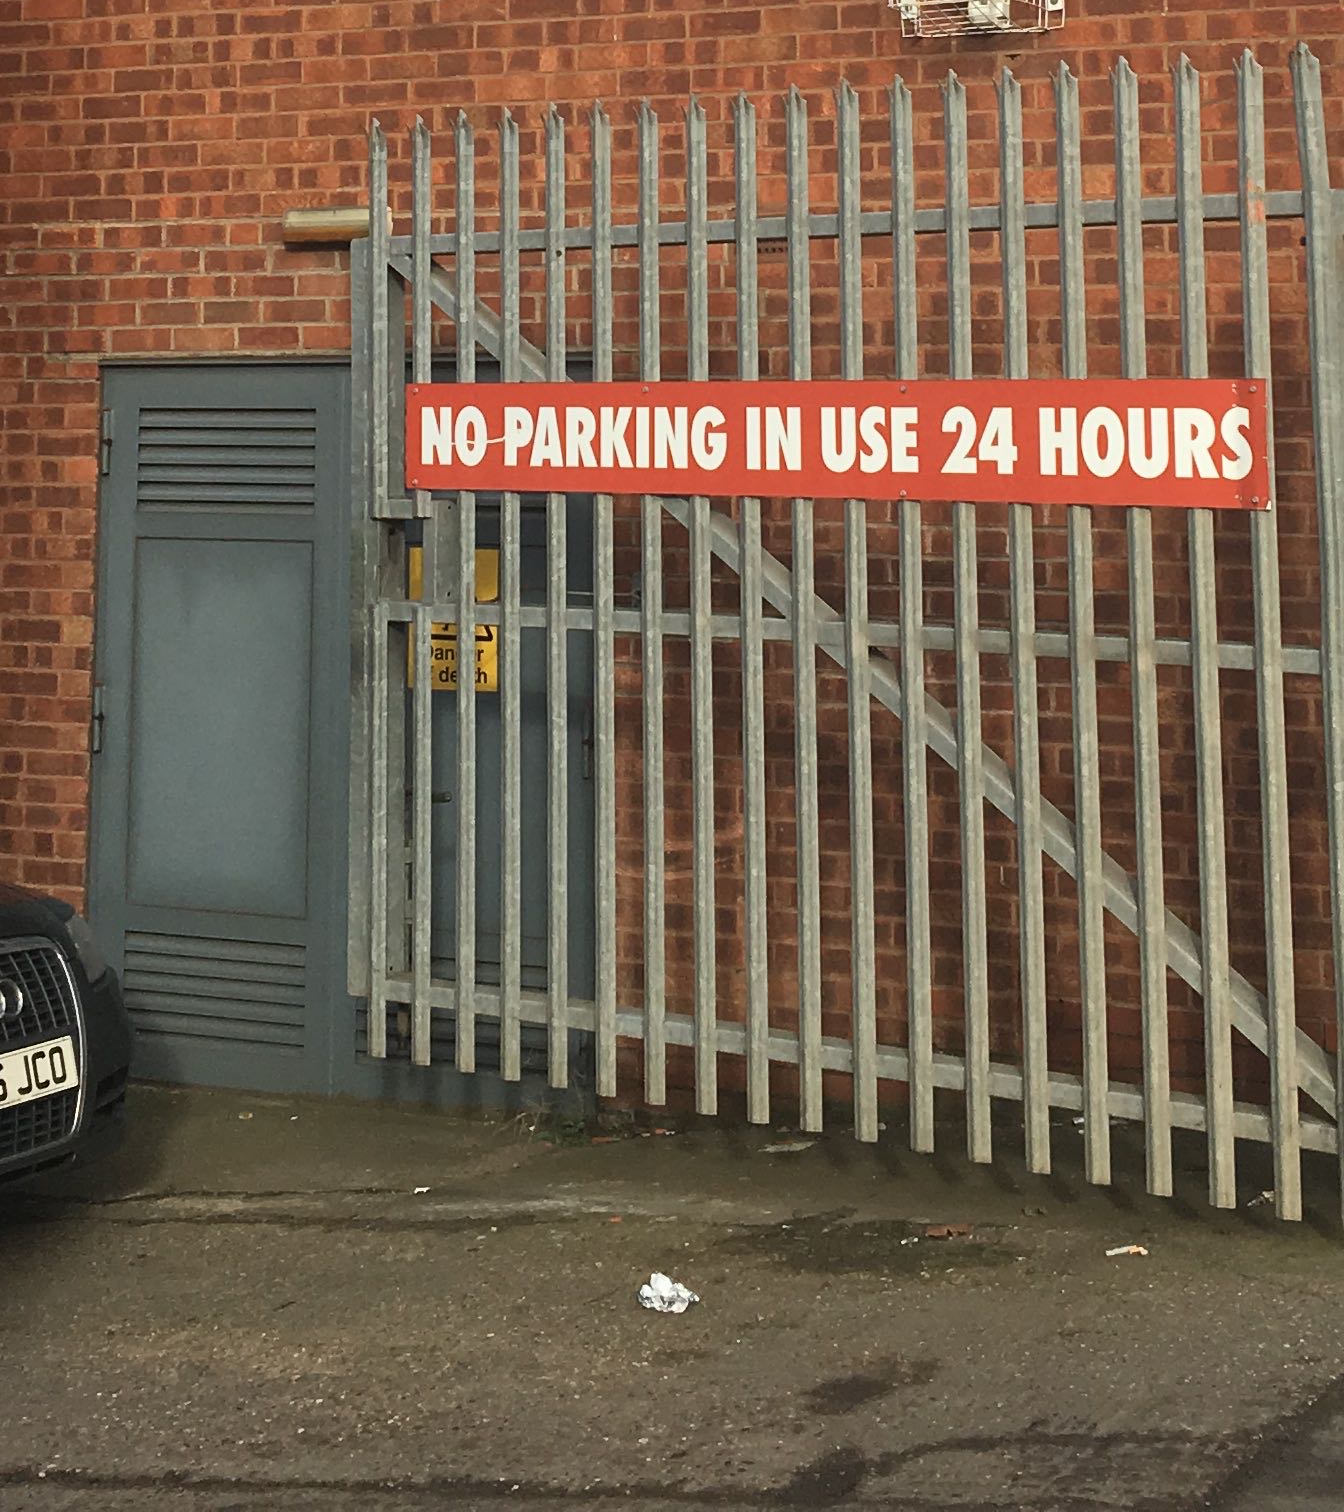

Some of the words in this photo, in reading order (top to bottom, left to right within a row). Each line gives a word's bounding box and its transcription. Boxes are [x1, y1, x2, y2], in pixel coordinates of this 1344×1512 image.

[421, 405, 488, 467] NO
[503, 405, 728, 472] PARKING
[745, 405, 802, 472] IN
[820, 405, 920, 474] USE
[940, 405, 1019, 475] 24
[1038, 405, 1254, 481] HOURS
[430, 645, 485, 662] anr
[438, 666, 488, 684] deh
[17, 1045, 67, 1096] JCO
